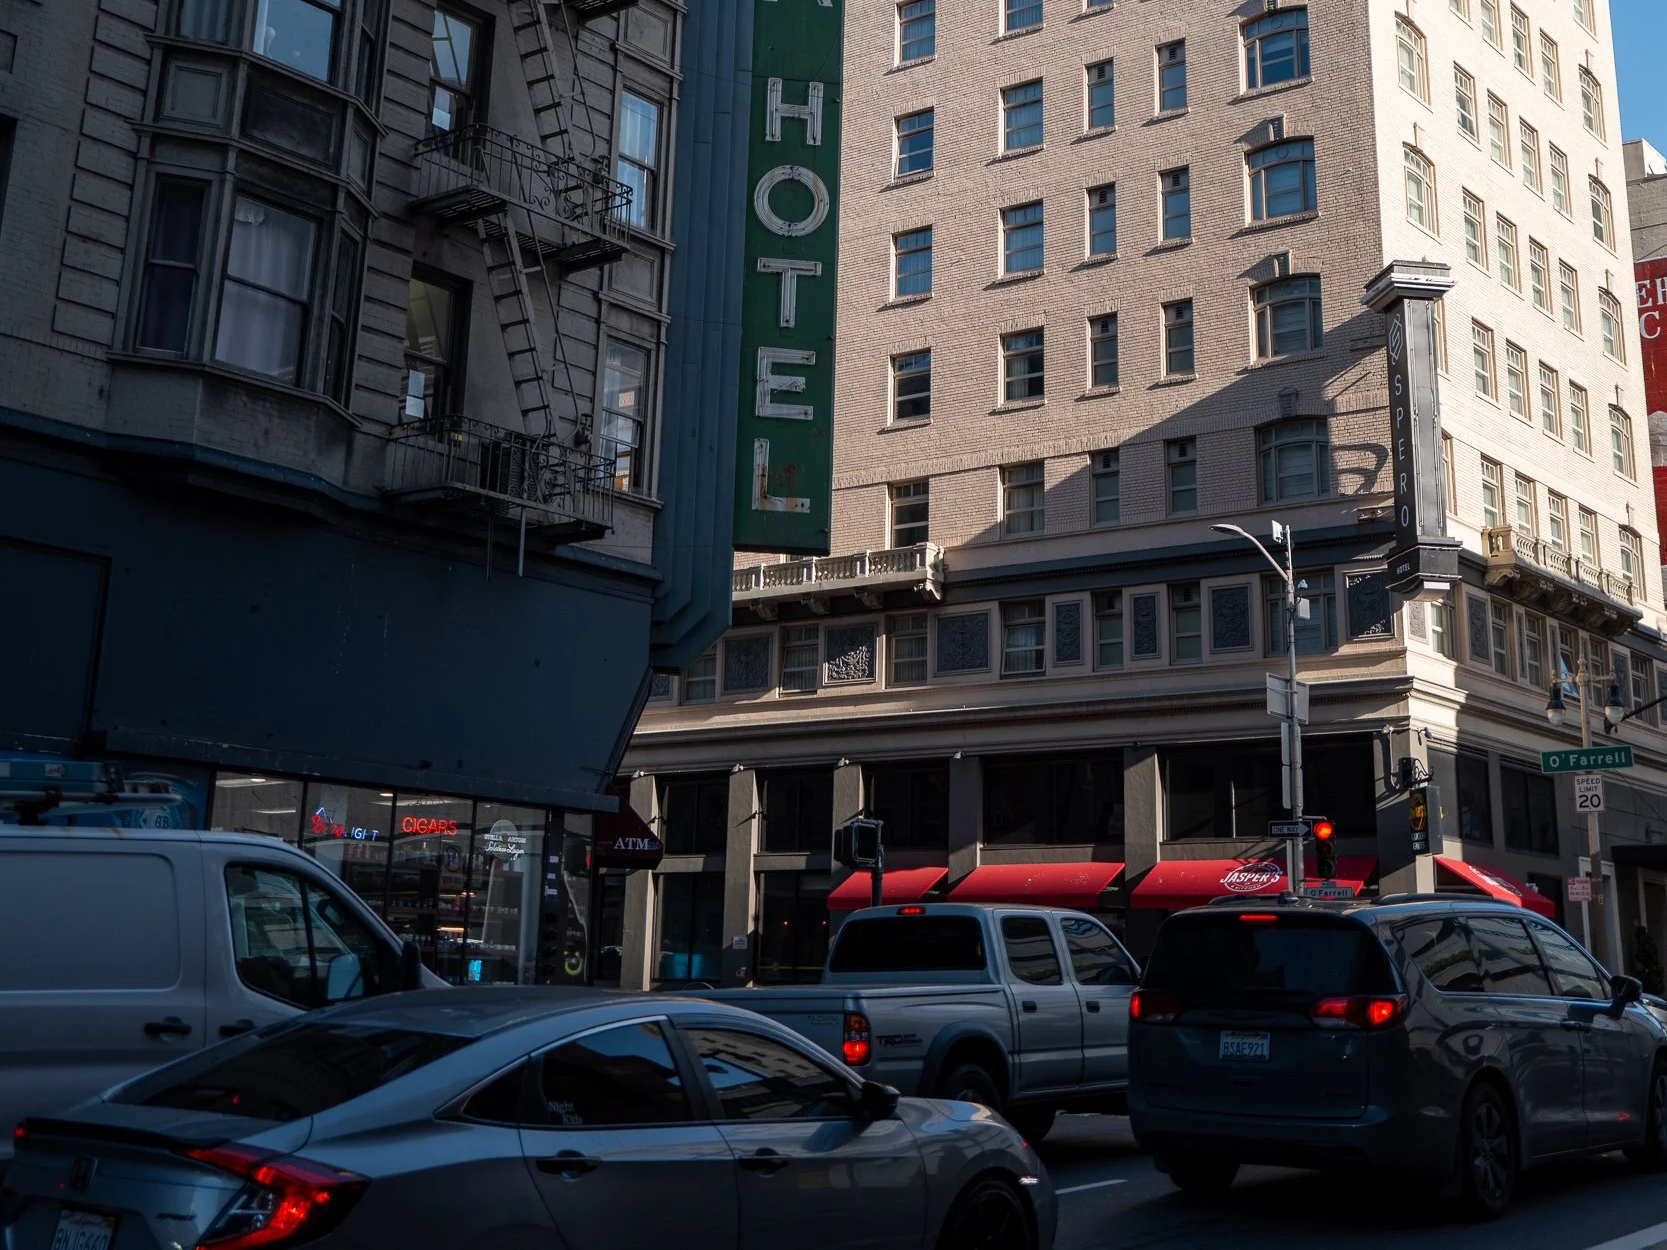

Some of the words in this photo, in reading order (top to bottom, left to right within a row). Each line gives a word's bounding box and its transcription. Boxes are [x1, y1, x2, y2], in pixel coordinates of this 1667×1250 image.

[751, 77, 830, 513] HOTEL
[1394, 375, 1410, 527] SPERO
[1396, 563, 1410, 575] HOTEL
[1549, 751, 1625, 768] O'Farrell
[1576, 777, 1601, 785] SPEED
[1578, 794, 1601, 809] 20
[402, 816, 457, 836] CIGARS
[613, 837, 650, 850] ATM
[1220, 870, 1284, 883] JASPER'S
